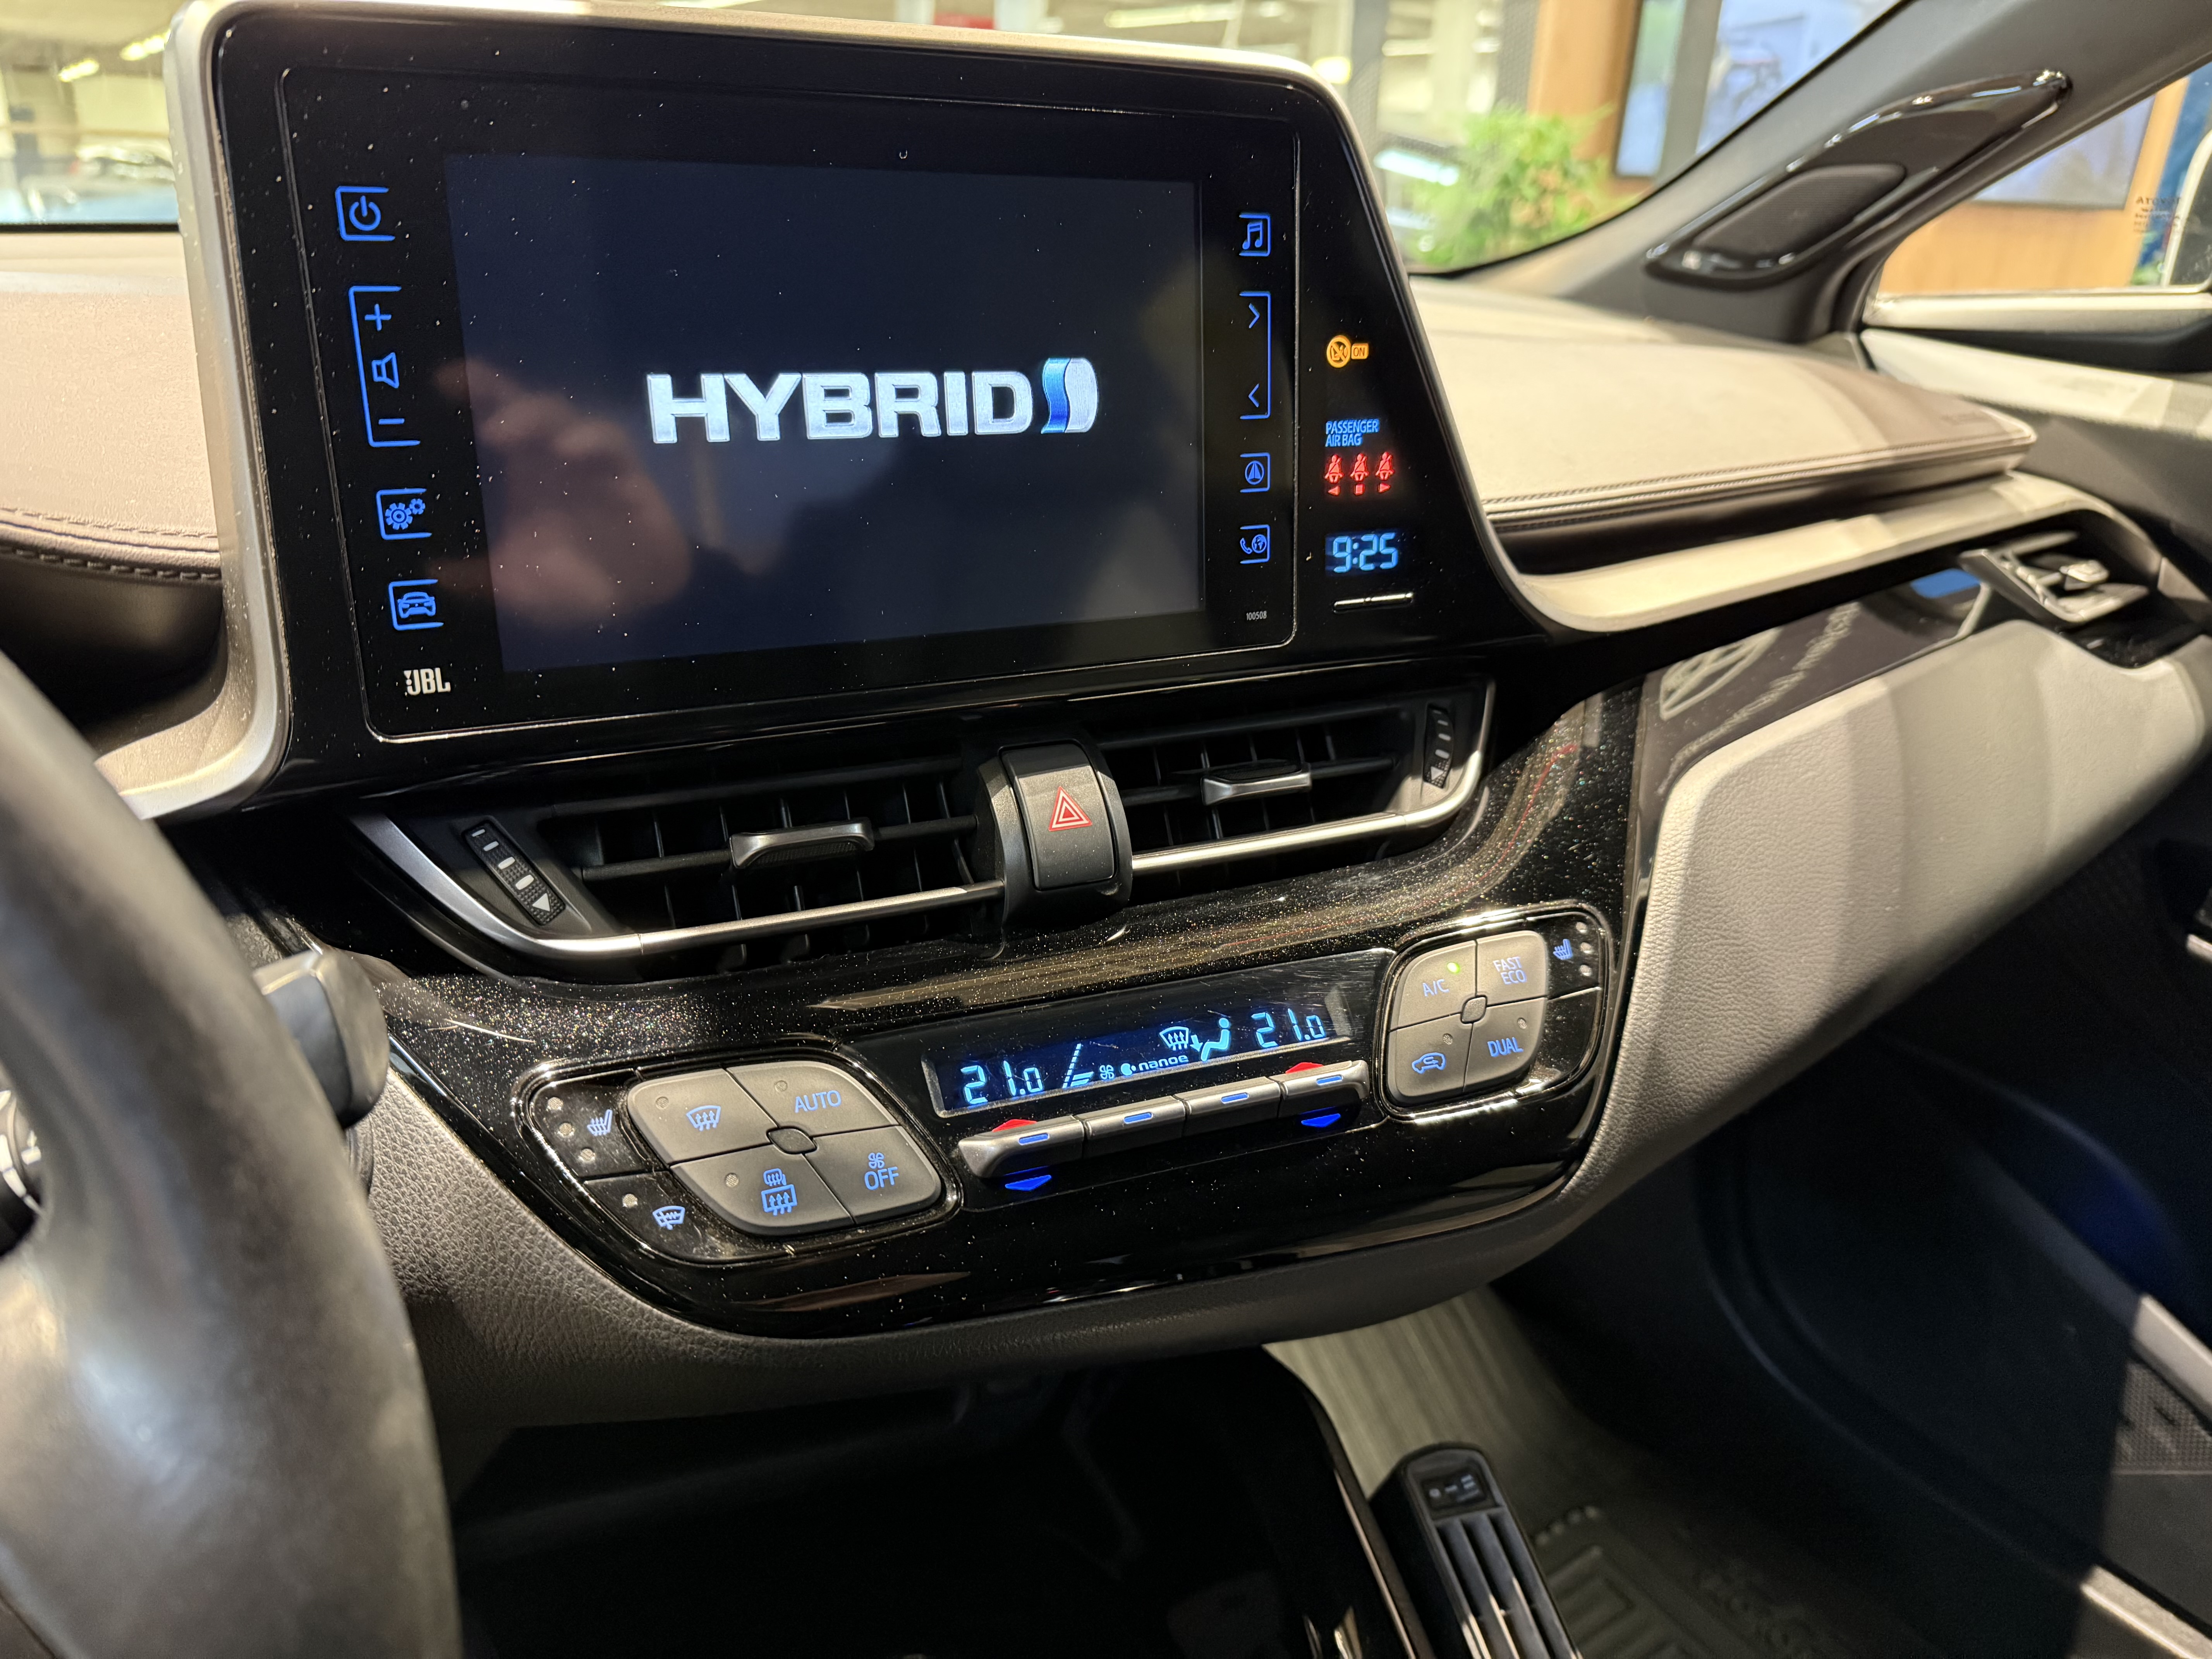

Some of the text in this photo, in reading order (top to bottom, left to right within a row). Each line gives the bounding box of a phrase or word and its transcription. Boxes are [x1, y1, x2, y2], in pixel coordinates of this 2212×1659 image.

[1353, 347, 1365, 357] ON
[646, 371, 1033, 444] HYBRID
[1326, 419, 1380, 434] PASSENGER
[1325, 433, 1362, 447] AIR BAG
[1333, 532, 1398, 573] 9:25
[1246, 611, 1267, 620] 100508
[404, 667, 451, 696] JBL
[1493, 957, 1523, 972] FAST
[1501, 970, 1527, 985] ECO
[1422, 979, 1449, 997] A/C
[1251, 1008, 1326, 1049] 21.0
[1487, 1037, 1523, 1057] DUAL
[1139, 1055, 1188, 1071] nanoe
[960, 1060, 1044, 1106] 21.0
[794, 1090, 842, 1113] AUTO
[864, 1166, 898, 1190] OFF
